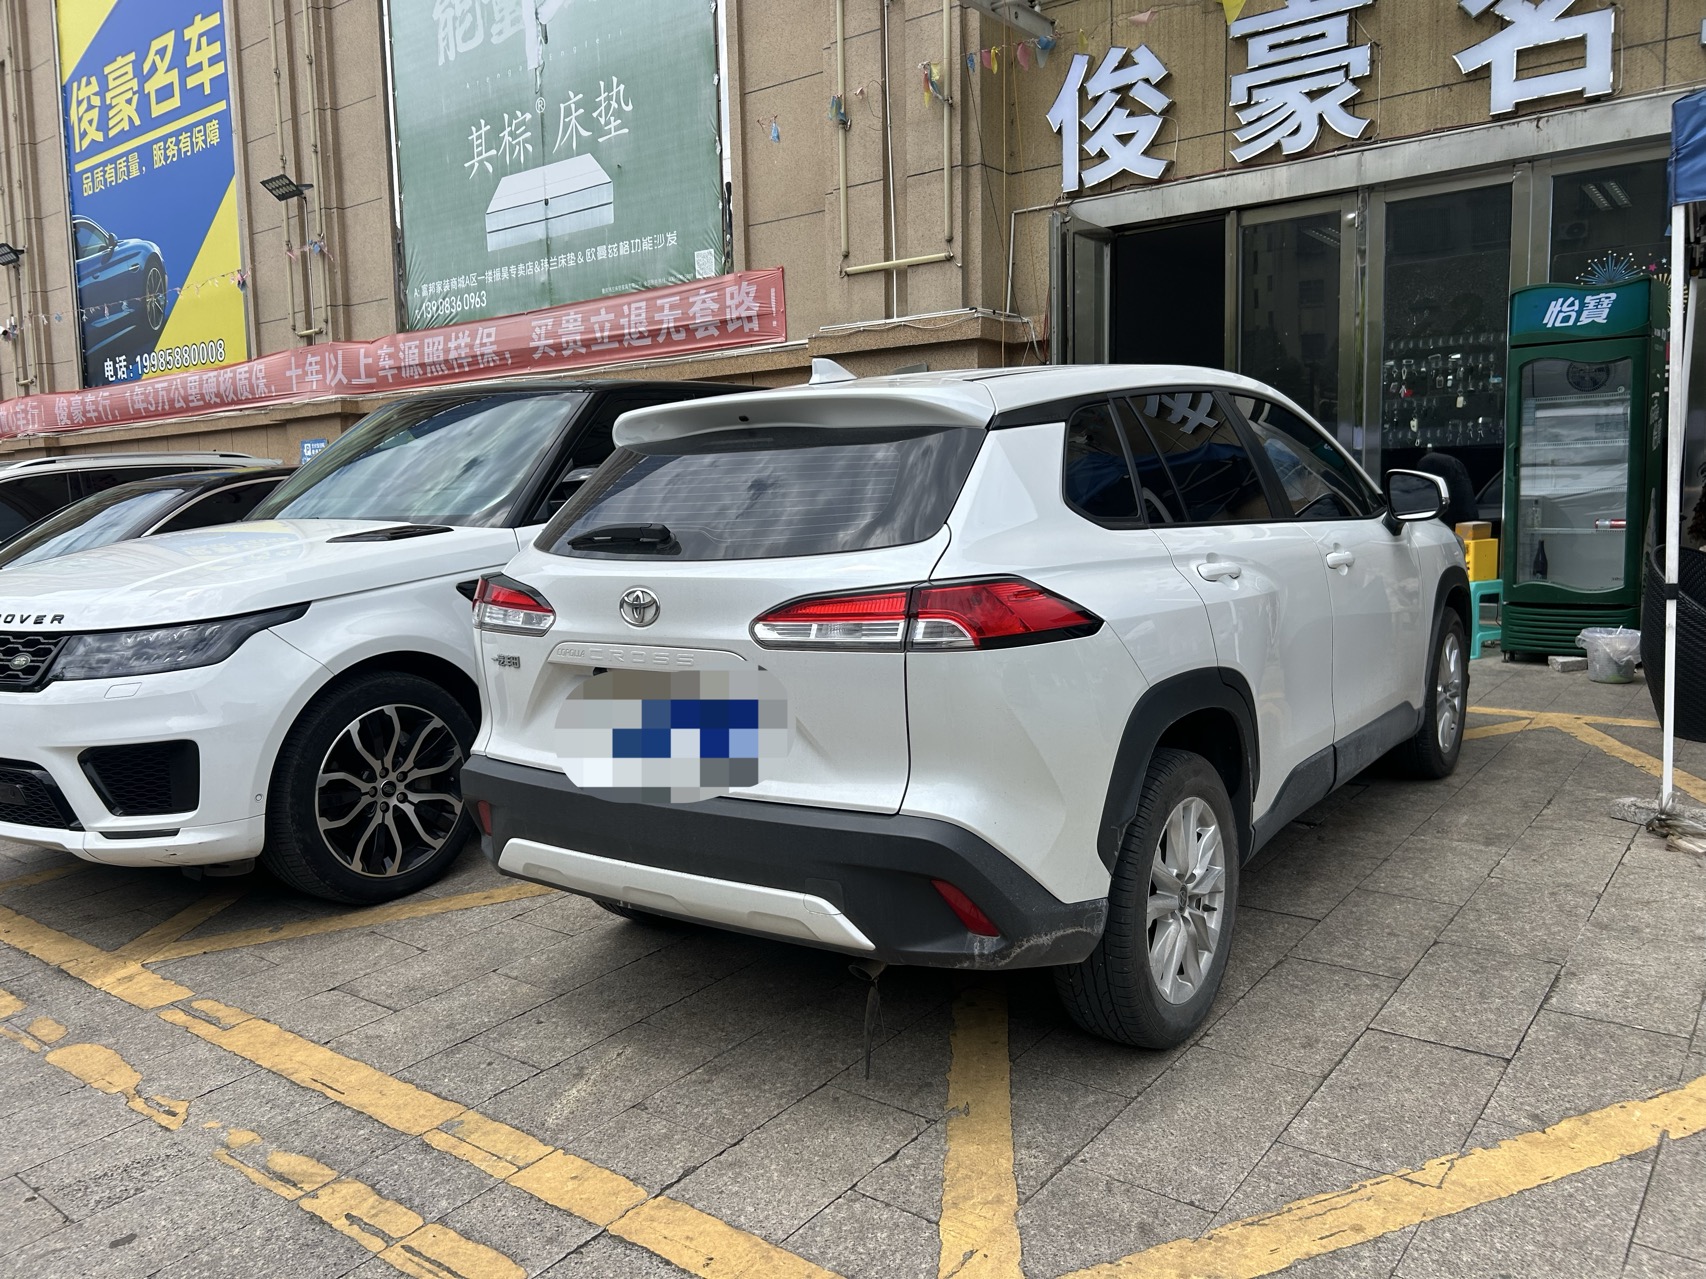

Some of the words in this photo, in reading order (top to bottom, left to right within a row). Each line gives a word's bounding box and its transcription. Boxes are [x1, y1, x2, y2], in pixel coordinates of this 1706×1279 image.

[70, 11, 225, 153] 俊豪名车
[553, 76, 633, 154] 床垫
[1046, 0, 1706, 191] 俊豪名
[82, 119, 220, 196] 品质有质量，服务有保障
[1542, 292, 1617, 328] 怡寶
[0, 613, 65, 625] OVER
[588, 647, 694, 667] CROSS
